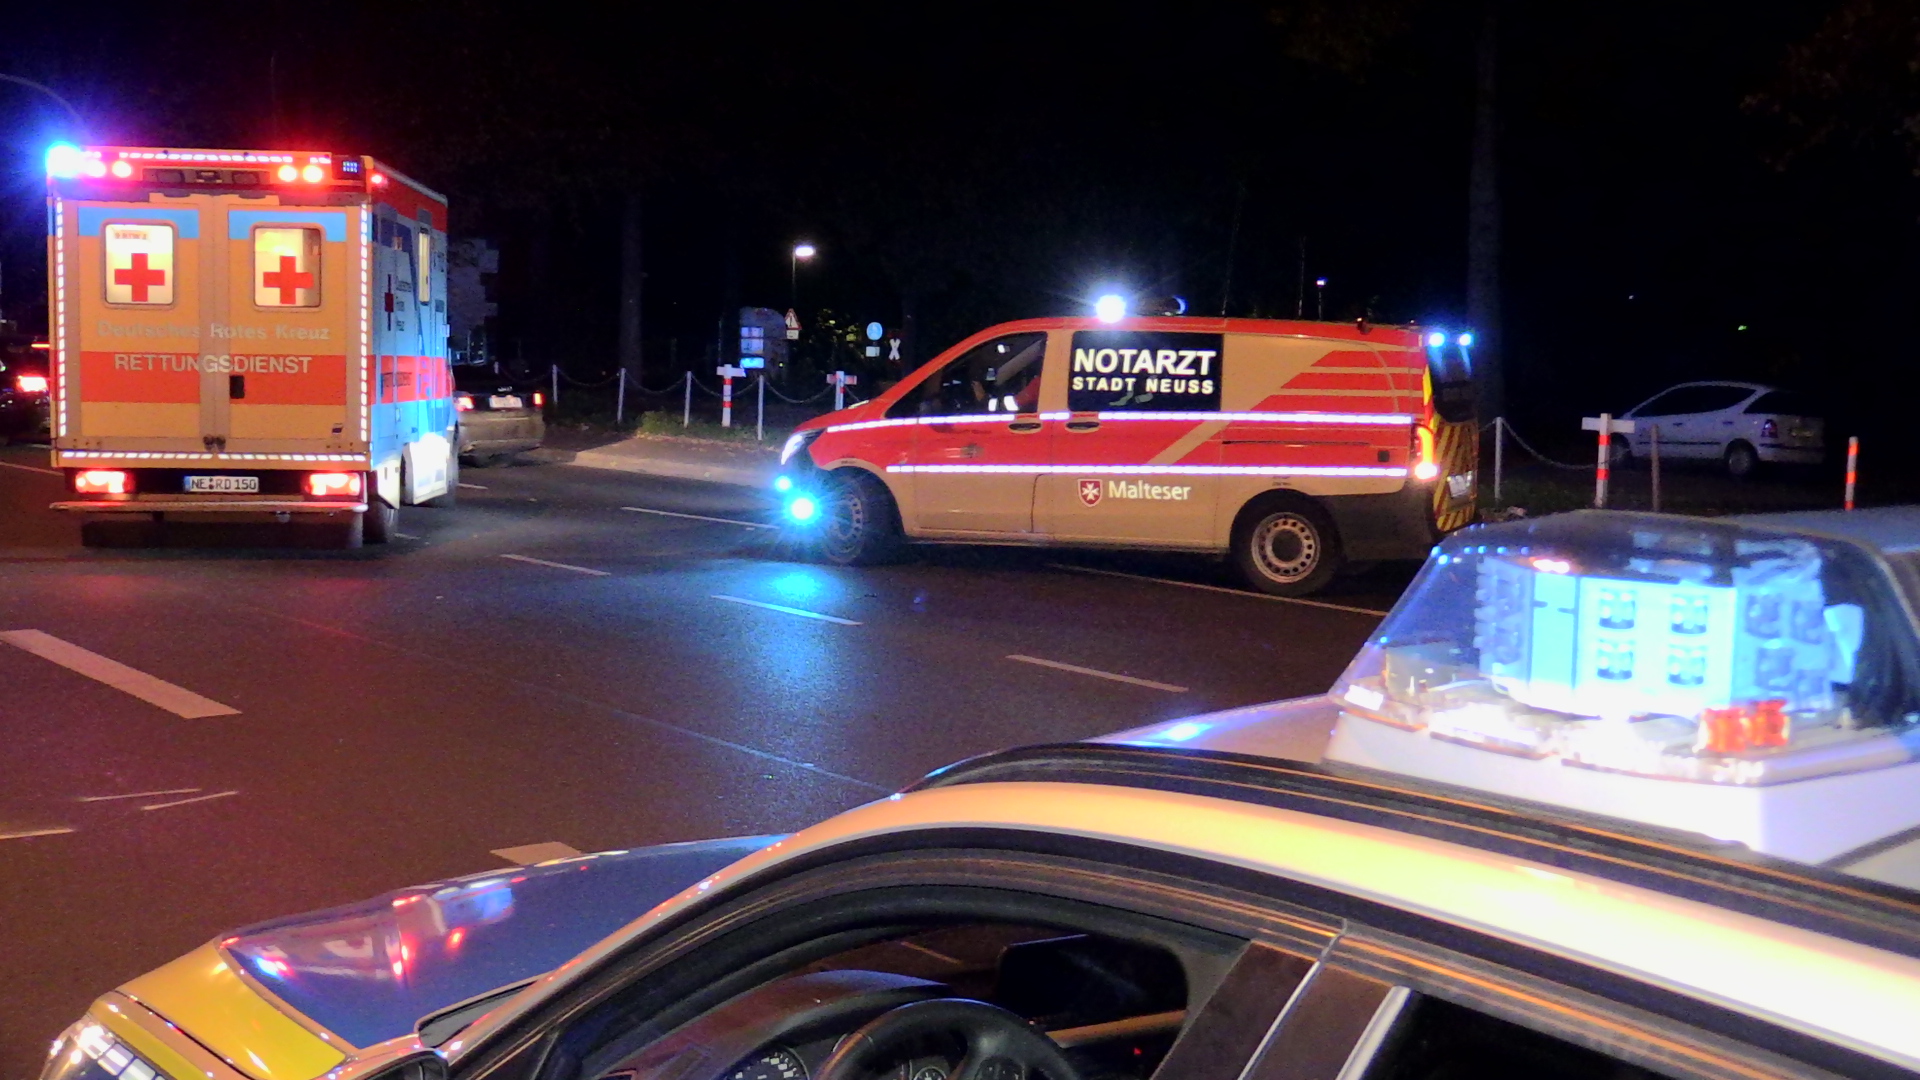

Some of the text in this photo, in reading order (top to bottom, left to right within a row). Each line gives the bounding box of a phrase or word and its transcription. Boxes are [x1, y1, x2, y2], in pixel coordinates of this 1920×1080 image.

[98, 321, 331, 341] Deutsches Rotes Kreuz
[114, 353, 312, 374] RETTUNGSDIENST
[1074, 348, 1216, 376] NOTARZT
[1072, 376, 1214, 395] STADT NEUSS
[234, 479, 257, 490] 150
[1108, 480, 1191, 500] Malteser
